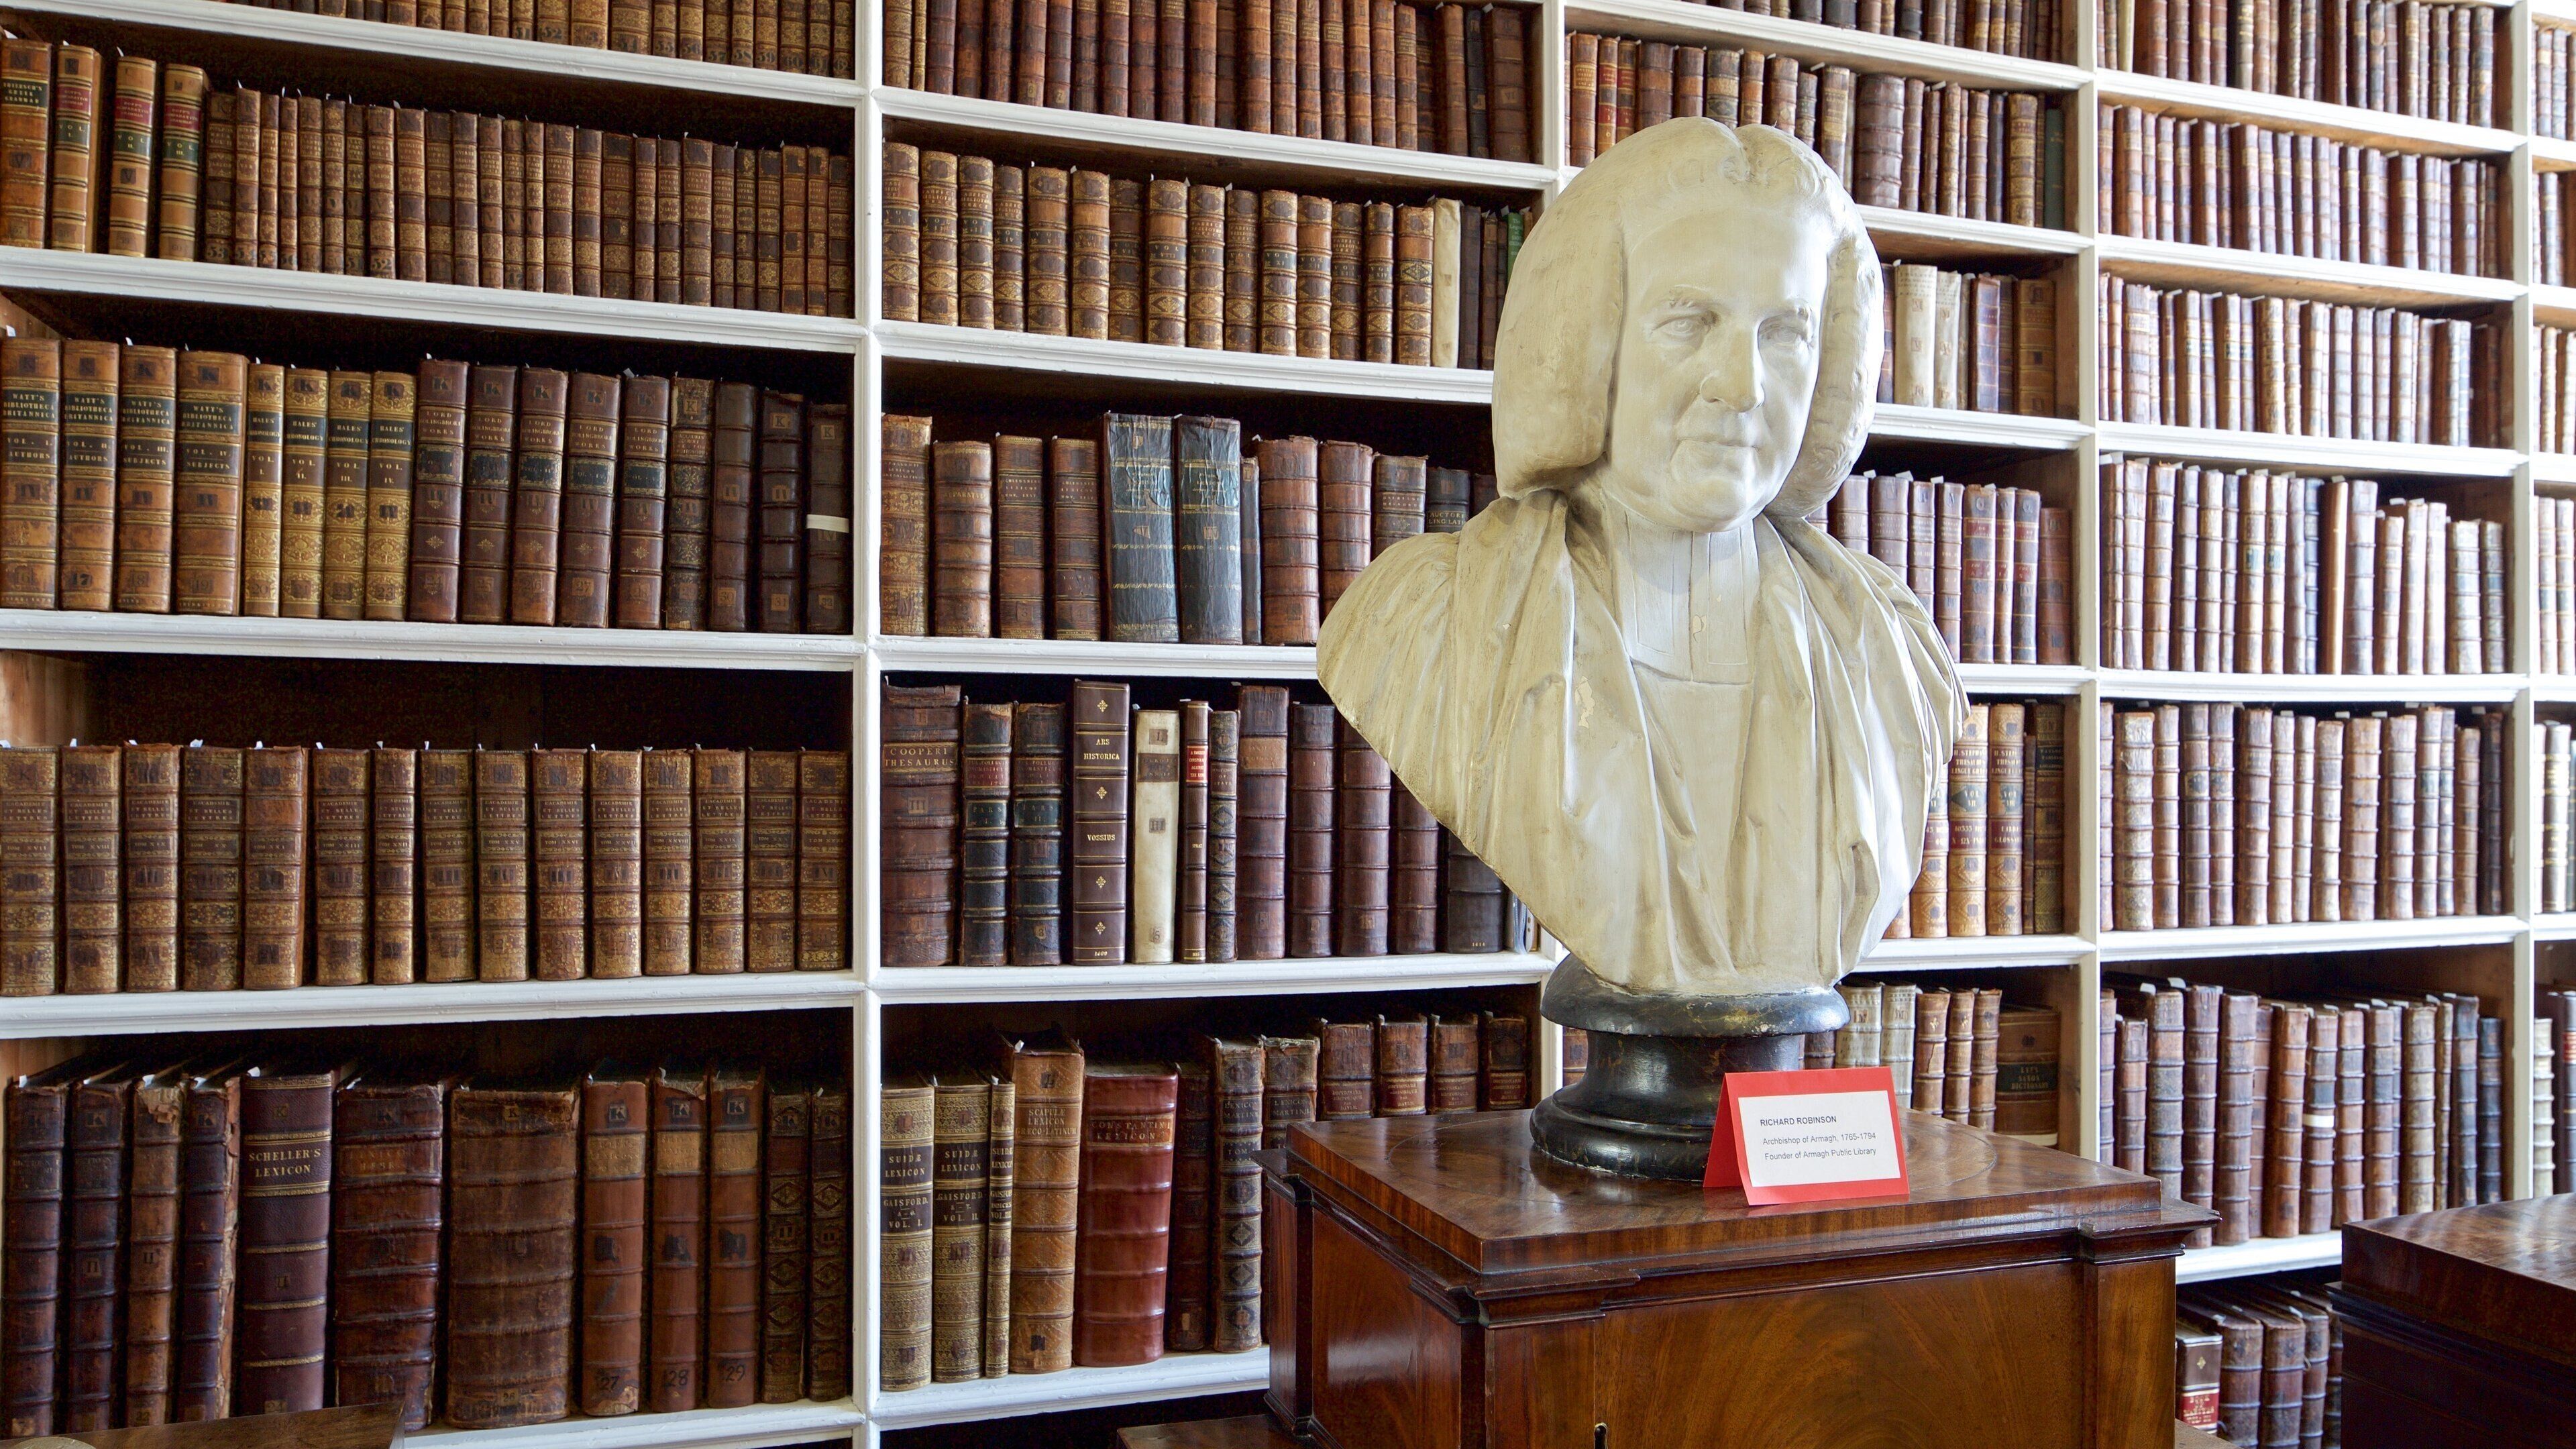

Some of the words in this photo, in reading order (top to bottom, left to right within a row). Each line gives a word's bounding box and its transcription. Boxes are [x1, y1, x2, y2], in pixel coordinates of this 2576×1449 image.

[12, 393, 44, 401] WATT'S
[193, 405, 224, 413] WATT'S
[686, 401, 696, 412] K
[776, 416, 786, 427] K
[824, 427, 833, 438] K
[123, 458, 166, 466] SUBJECTS
[186, 462, 231, 470] SUBJECTS
[337, 462, 360, 470] VOL.
[72, 573, 91, 586] 17
[575, 578, 590, 592] 27
[378, 586, 394, 598] 23
[720, 590, 735, 602] 30
[774, 596, 786, 608] 31
[1021, 606, 1028, 617] 3
[891, 747, 947, 755] COOPERI
[884, 758, 955, 767] THESAURUS
[1084, 753, 1120, 761] HISTORICA
[508, 1108, 518, 1118] K
[610, 1107, 625, 1120] K
[674, 1104, 690, 1116] K
[729, 1102, 745, 1114] K
[1028, 1118, 1065, 1126] LEXICON
[1092, 1122, 1171, 1130] CONSTANTINI
[1760, 1118, 1795, 1126] RICHARD
[1797, 1116, 1837, 1124] ROBINSON
[1763, 1136, 1801, 1145] Archbishop
[1803, 1135, 1809, 1143] of
[1811, 1135, 1839, 1143] Armagh,
[1841, 1132, 1876, 1140] 1765-1794
[249, 1148, 321, 1162] SCHELLER'S
[1765, 1152, 1792, 1161] Founder
[1803, 1150, 1829, 1159] Armagh
[1831, 1148, 1851, 1157] Public
[1854, 1148, 1876, 1157] Library
[255, 1165, 311, 1178] LEXICON
[885, 1167, 925, 1177] LEXICON
[941, 1163, 981, 1172] LEXICON
[883, 1197, 928, 1206] GAISFORD.
[943, 1214, 965, 1222] VOL.
[888, 1220, 910, 1229] VOL.
[669, 1370, 688, 1387] 28
[726, 1366, 746, 1382] 29
[601, 1377, 619, 1391] 27
[503, 1393, 515, 1402] 26
